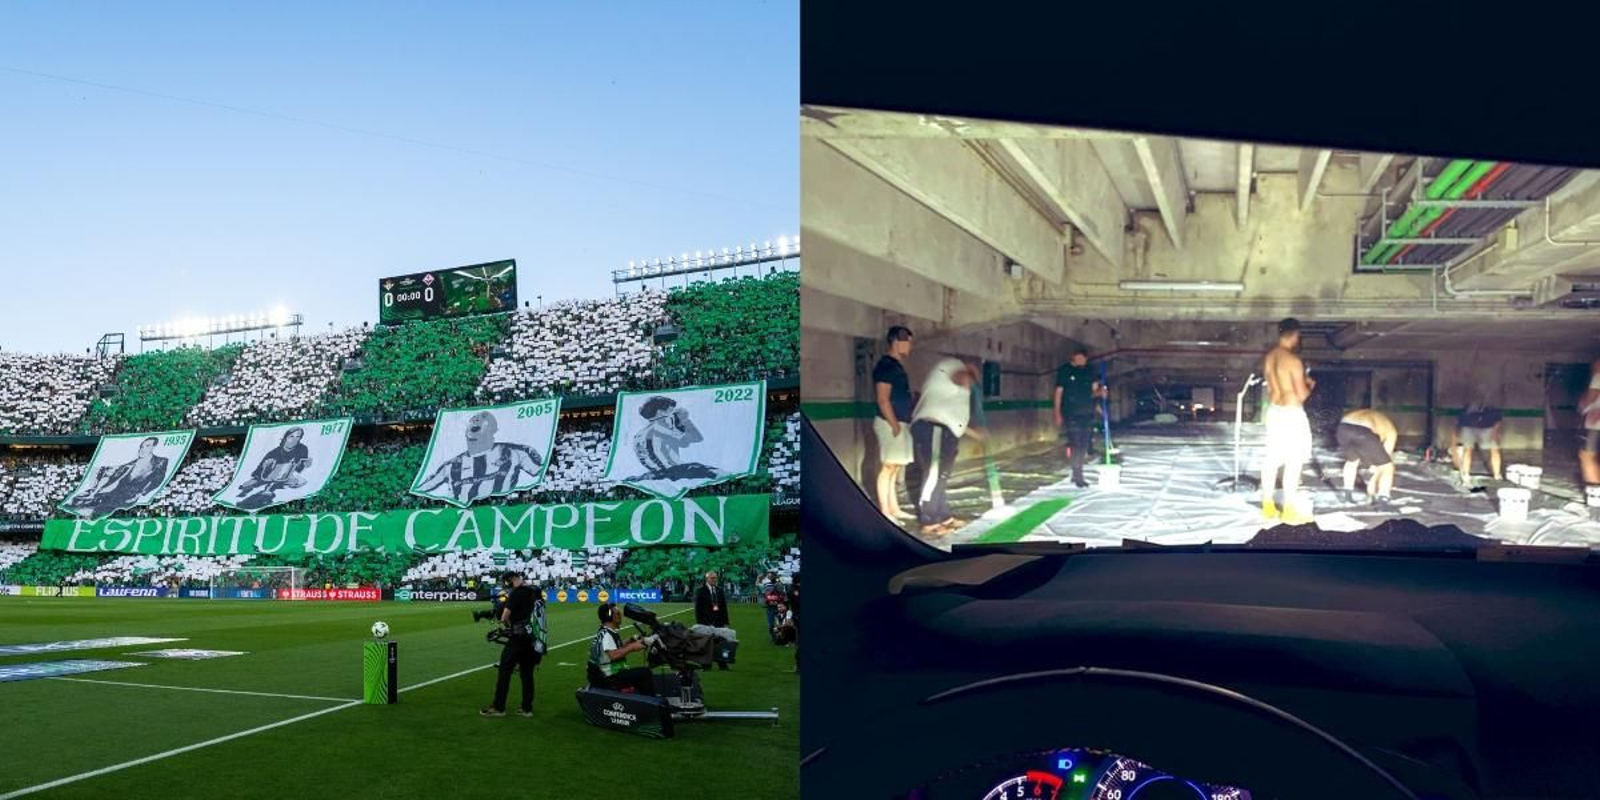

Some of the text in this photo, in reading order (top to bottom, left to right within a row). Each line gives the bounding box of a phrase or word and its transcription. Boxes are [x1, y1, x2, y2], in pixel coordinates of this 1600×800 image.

[384, 287, 433, 307] 0 00:00 0
[714, 388, 753, 403] 2022
[517, 404, 553, 419] 2005
[320, 422, 345, 436] 1977
[163, 435, 187, 446] 1935
[66, 516, 292, 554] ESPIRITU
[337, 589, 377, 598] STRAUSS
[399, 589, 477, 602] enterprise
[1121, 770, 1136, 781] 80
[1017, 786, 1025, 797] 5
[1107, 789, 1121, 800] 60
